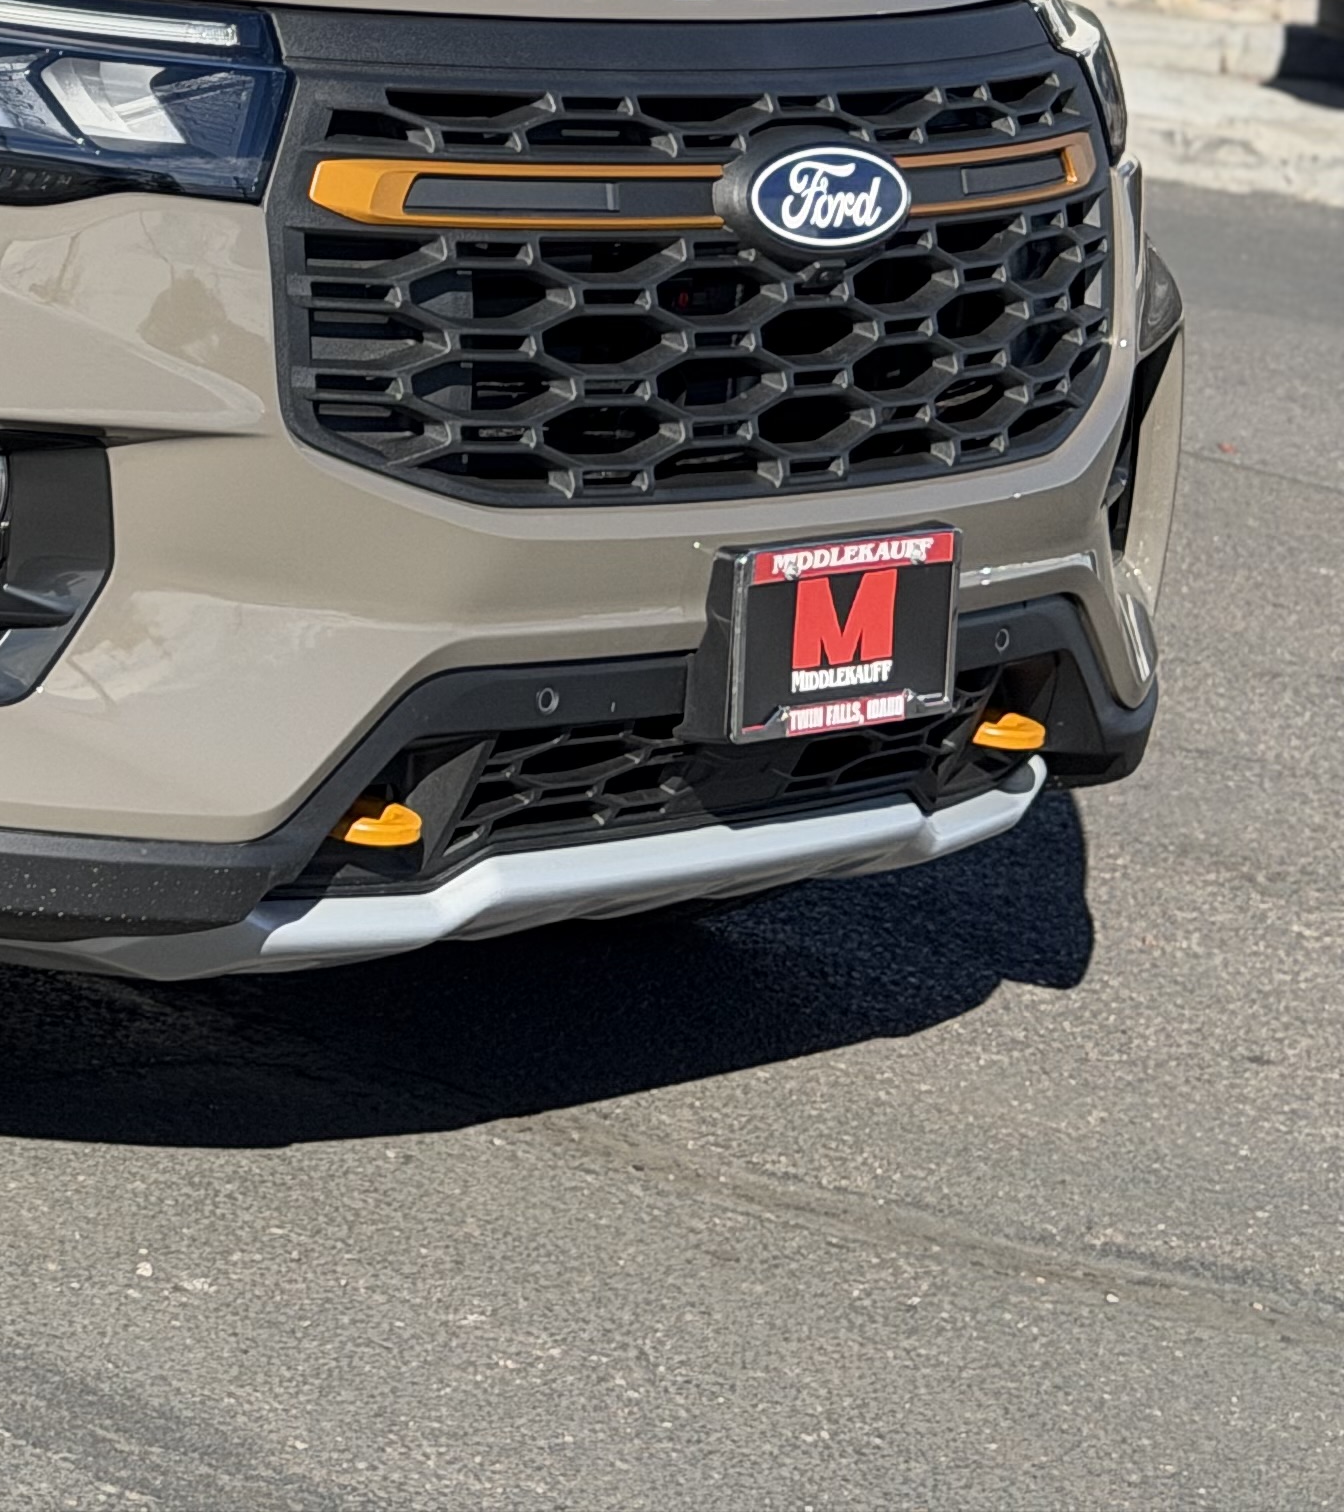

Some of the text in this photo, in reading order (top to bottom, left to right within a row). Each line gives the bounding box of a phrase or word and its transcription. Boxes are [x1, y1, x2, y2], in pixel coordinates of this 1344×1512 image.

[780, 160, 882, 229] Ford
[771, 537, 934, 576] MIDDLEKAUFF
[792, 568, 898, 669] M
[791, 659, 893, 693] MIDDLEKAUFF
[789, 695, 904, 731] TWIN FALLS, IDAHO
